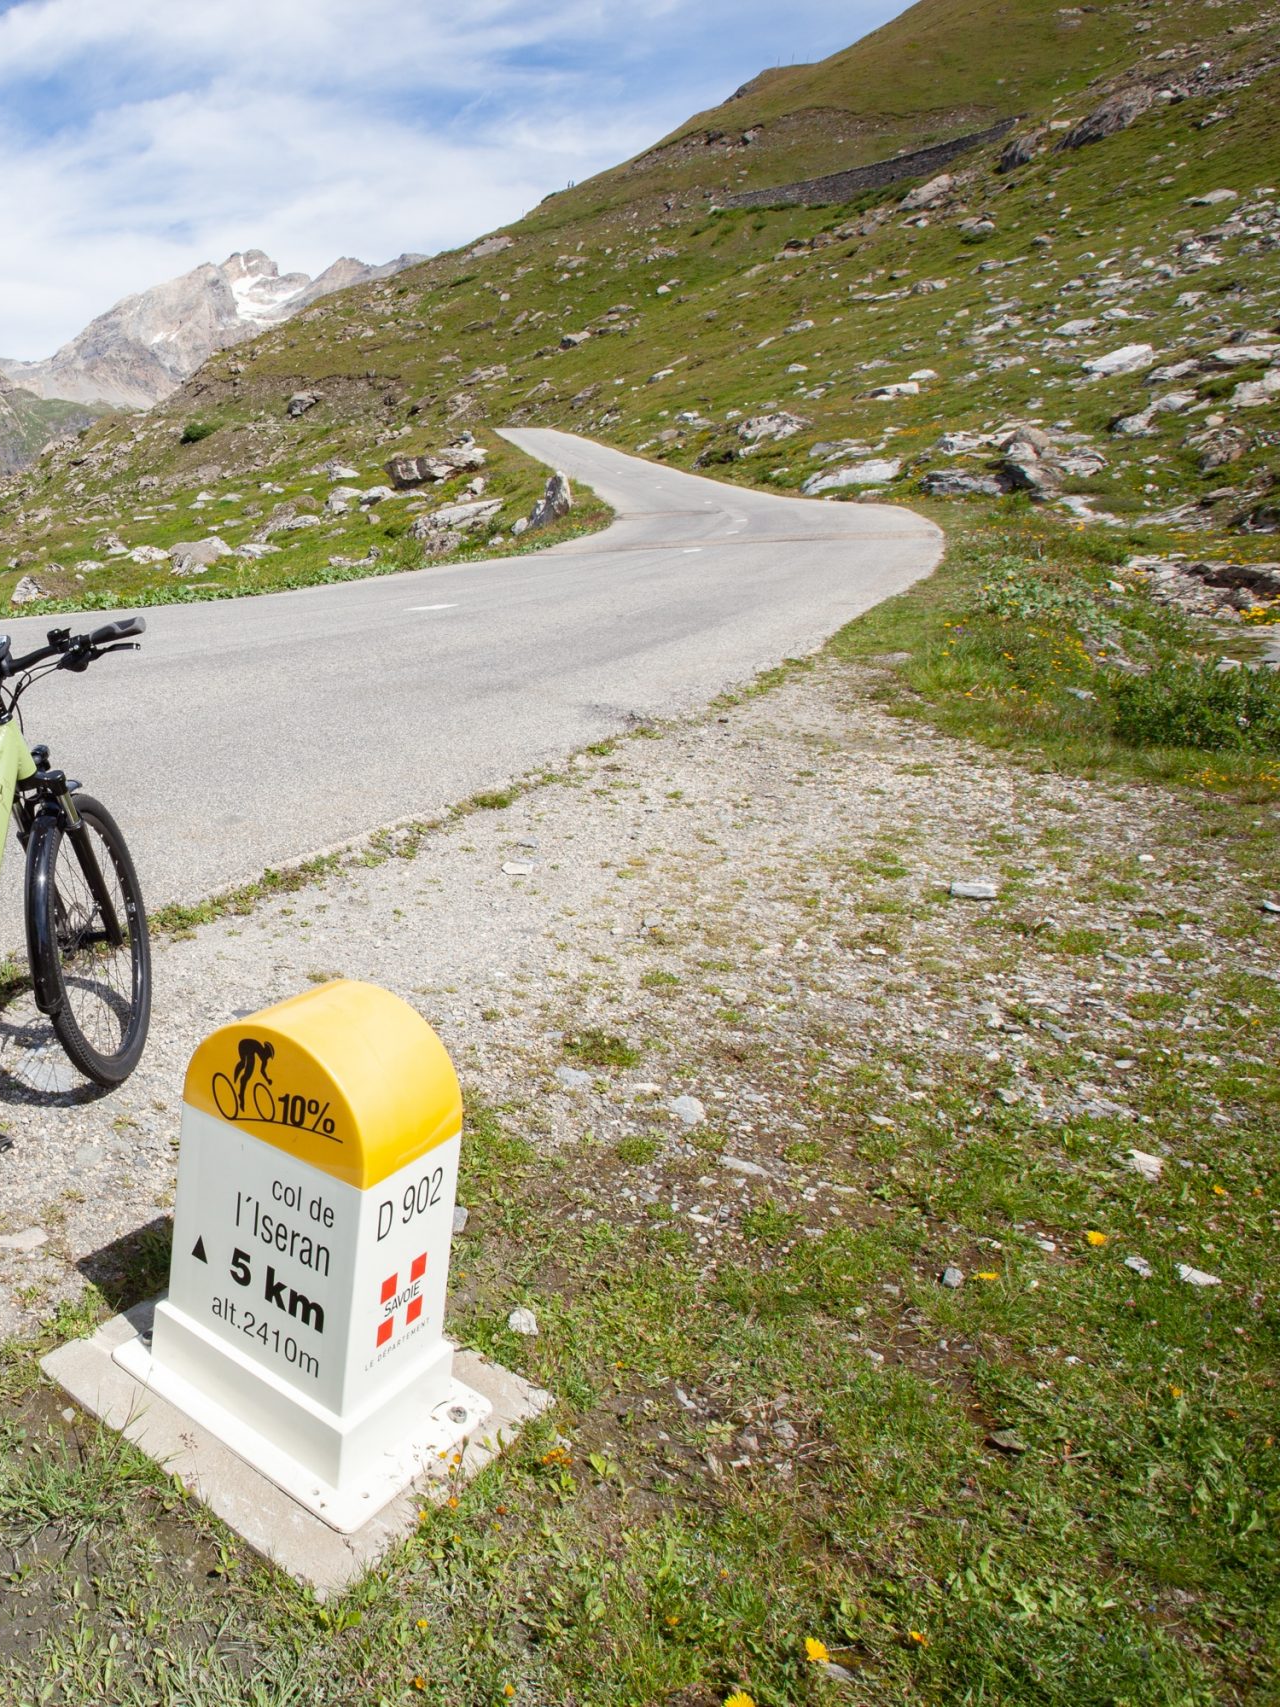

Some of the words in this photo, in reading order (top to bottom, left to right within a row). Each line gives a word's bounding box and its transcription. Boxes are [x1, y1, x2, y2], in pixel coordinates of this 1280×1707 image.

[278, 1093, 336, 1135] 10%
[235, 1191, 331, 1277] l'Iseran
[271, 1180, 302, 1212] col
[309, 1196, 335, 1229] de
[377, 1200, 394, 1243] D
[402, 1166, 443, 1224] 902
[230, 1247, 252, 1287] 5
[264, 1265, 325, 1334] km
[384, 1280, 421, 1318] SAVOIE
[211, 1297, 320, 1378] alt.2410m
[364, 1360, 374, 1372] LE
